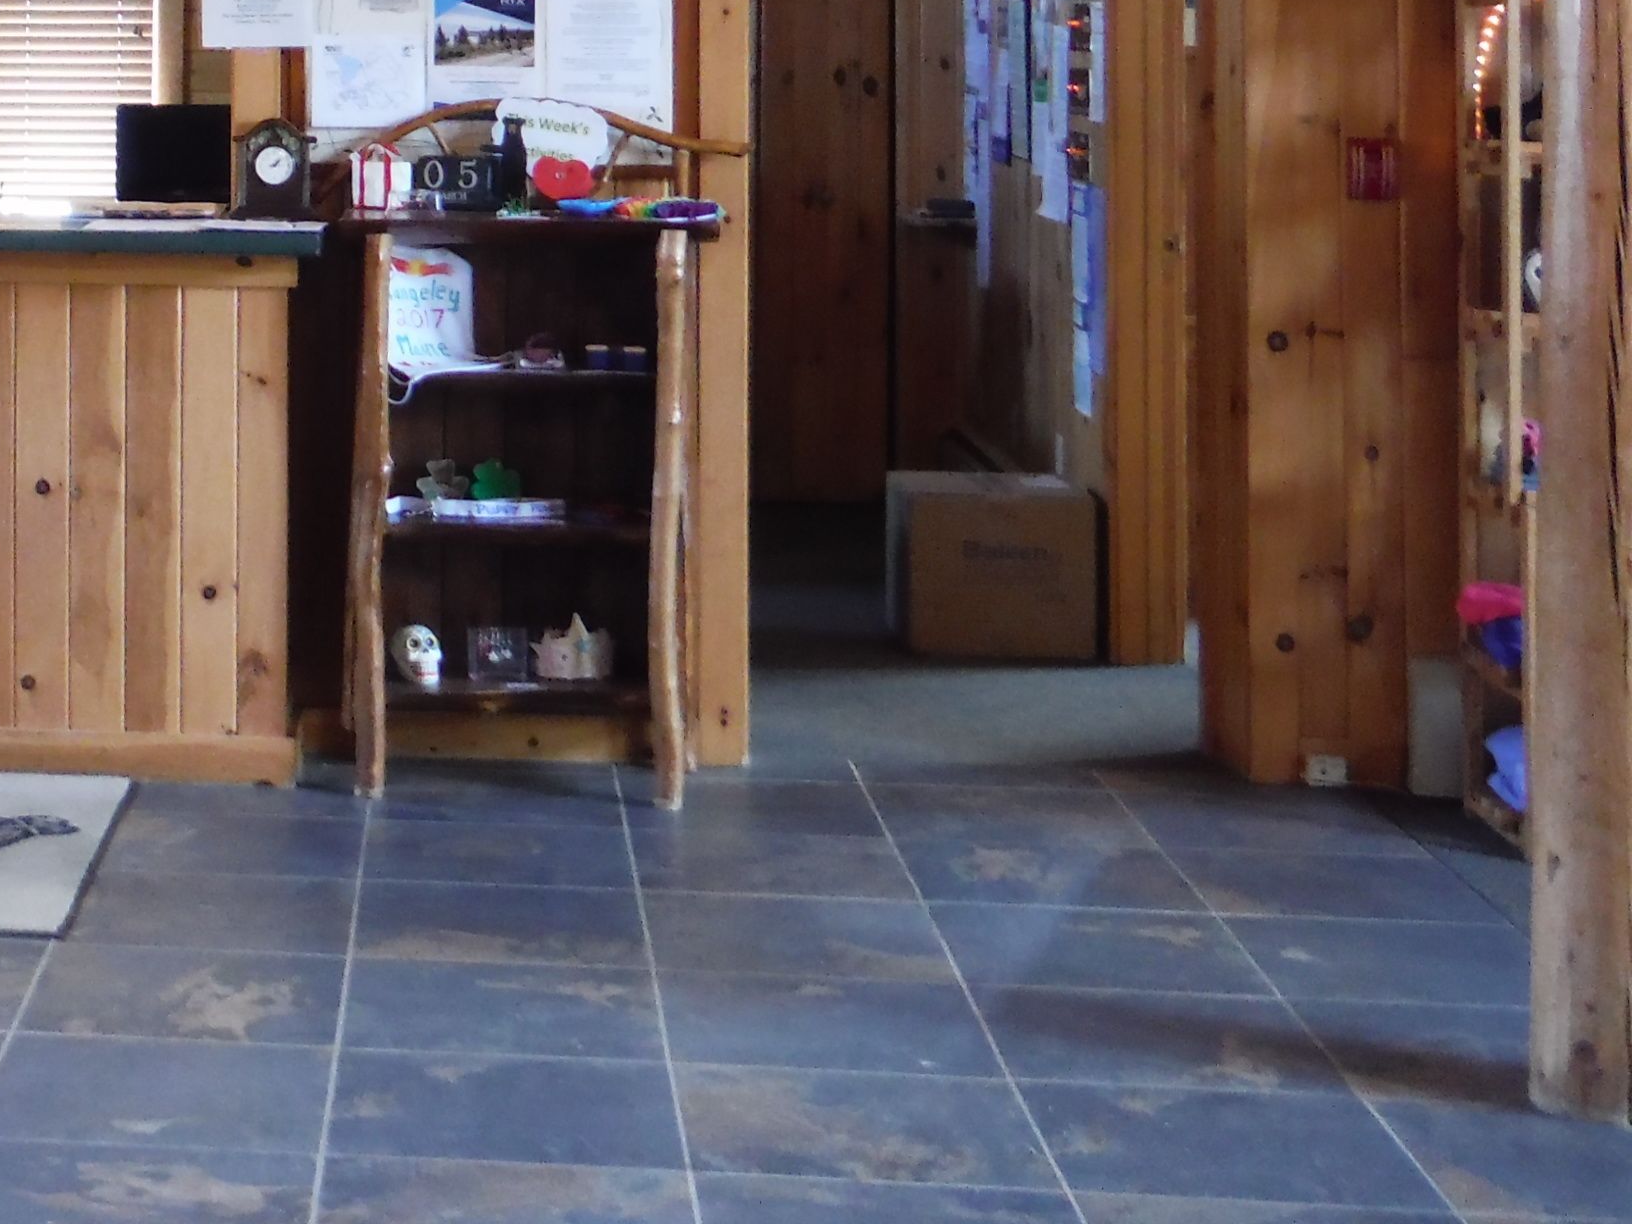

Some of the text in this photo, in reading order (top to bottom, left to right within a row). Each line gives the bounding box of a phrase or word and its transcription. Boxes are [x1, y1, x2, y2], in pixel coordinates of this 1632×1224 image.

[538, 117, 589, 135] Week's
[527, 146, 574, 161] ctivities
[391, 279, 460, 312] angeley
[396, 308, 435, 329] 2017
